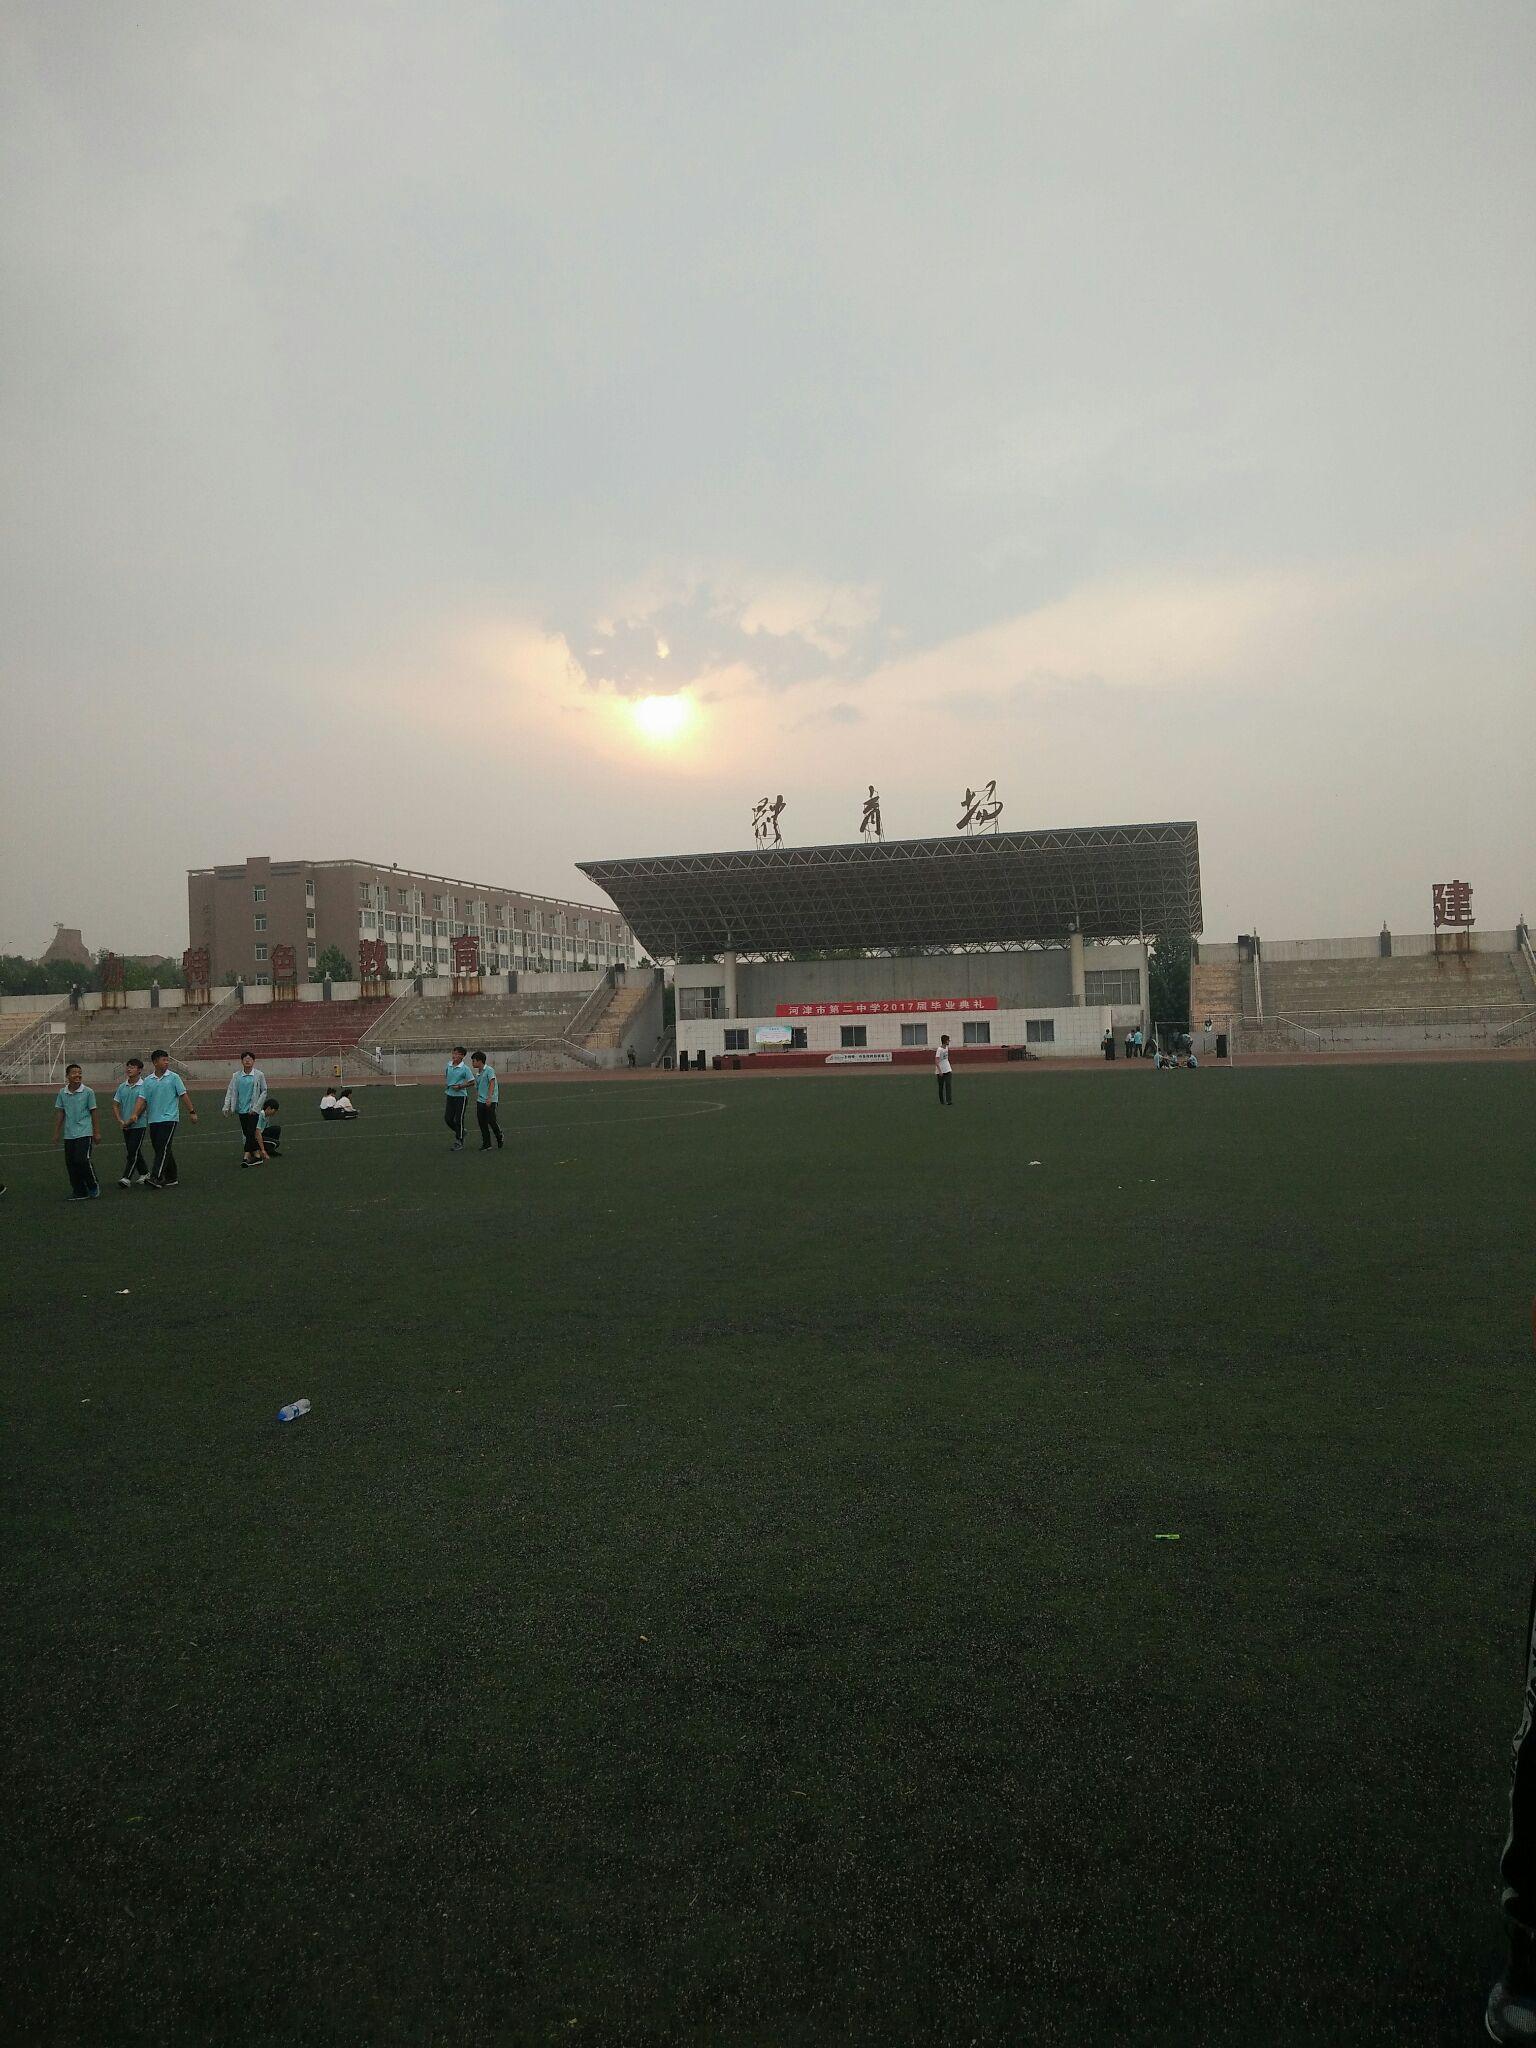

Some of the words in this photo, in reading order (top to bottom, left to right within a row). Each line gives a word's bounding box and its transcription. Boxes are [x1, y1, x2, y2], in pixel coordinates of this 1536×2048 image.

[1432, 880, 1476, 928] 建
[788, 998, 985, 1016] 河津市第二中学2017届毕业典礼
